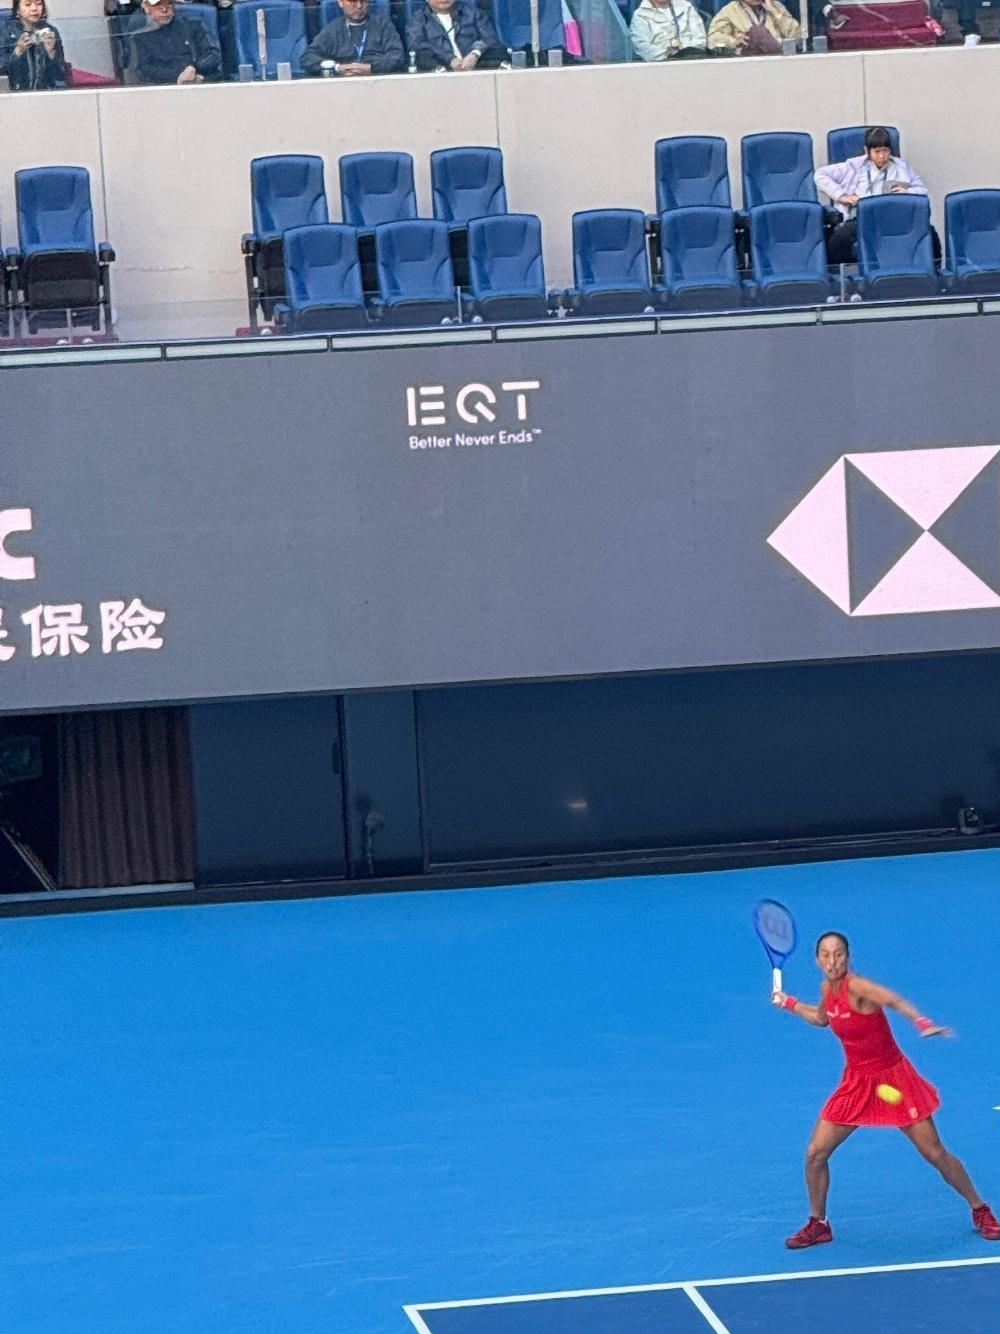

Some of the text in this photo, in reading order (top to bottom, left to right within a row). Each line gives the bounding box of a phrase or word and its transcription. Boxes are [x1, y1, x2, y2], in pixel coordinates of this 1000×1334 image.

[406, 380, 541, 426] EQT
[408, 434, 453, 450] Better
[454, 431, 496, 448] Never
[0, 597, 166, 662] 保险
